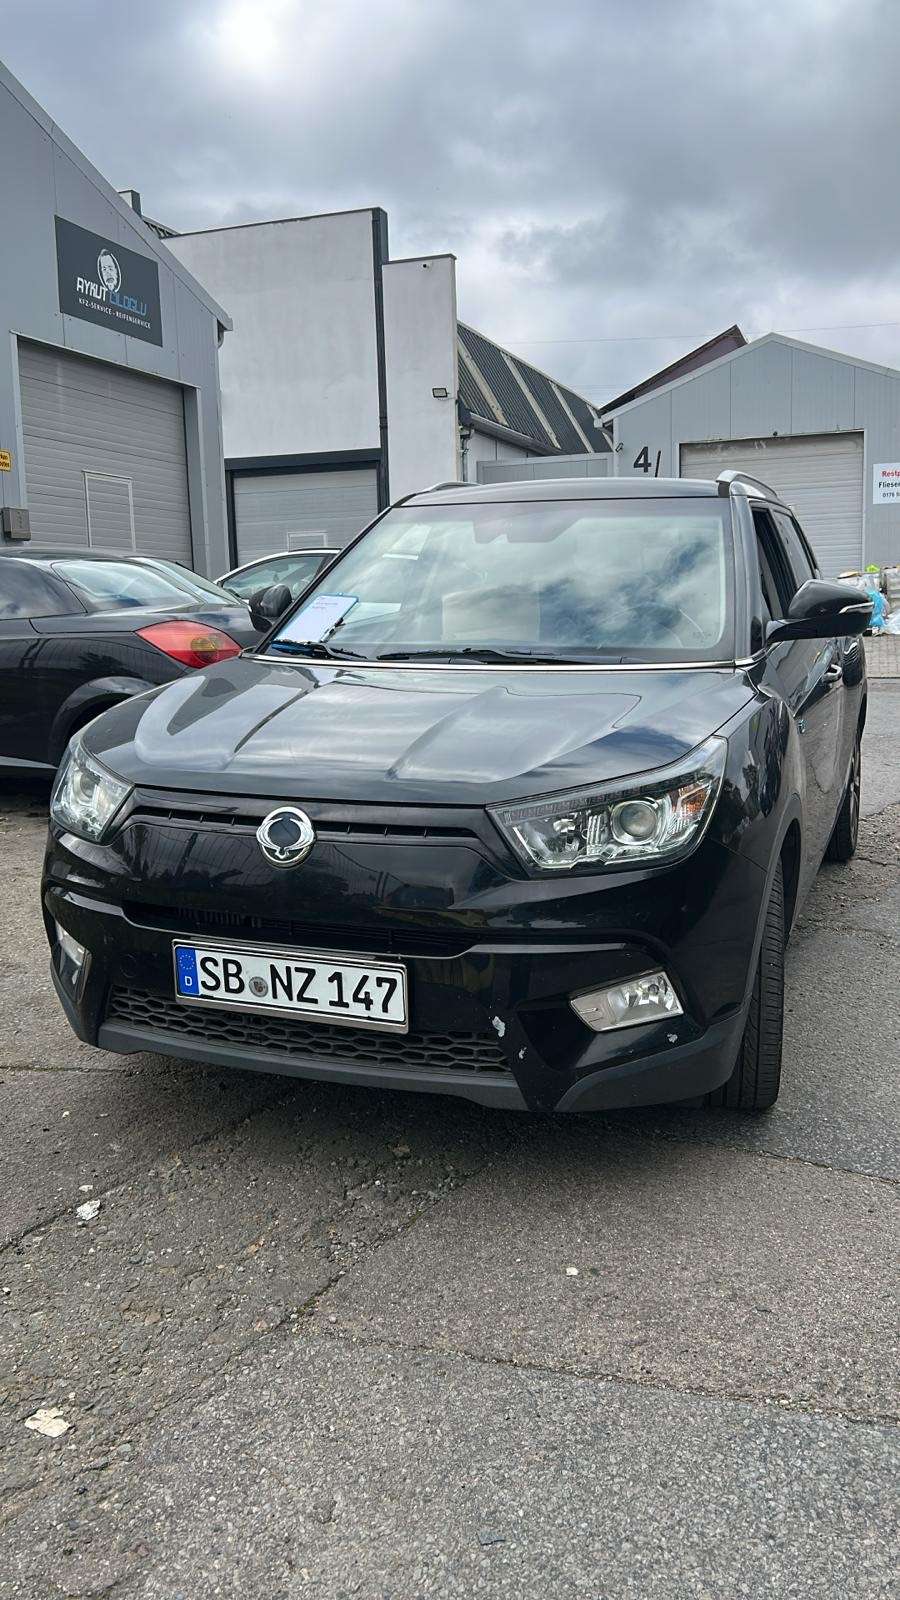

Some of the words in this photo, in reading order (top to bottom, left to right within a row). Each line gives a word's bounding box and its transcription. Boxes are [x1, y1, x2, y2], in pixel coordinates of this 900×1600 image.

[76, 276, 108, 302] AYKUT
[185, 976, 193, 987] D
[199, 956, 246, 995] SB
[269, 963, 319, 1005] NZ
[327, 970, 398, 1014] 147
